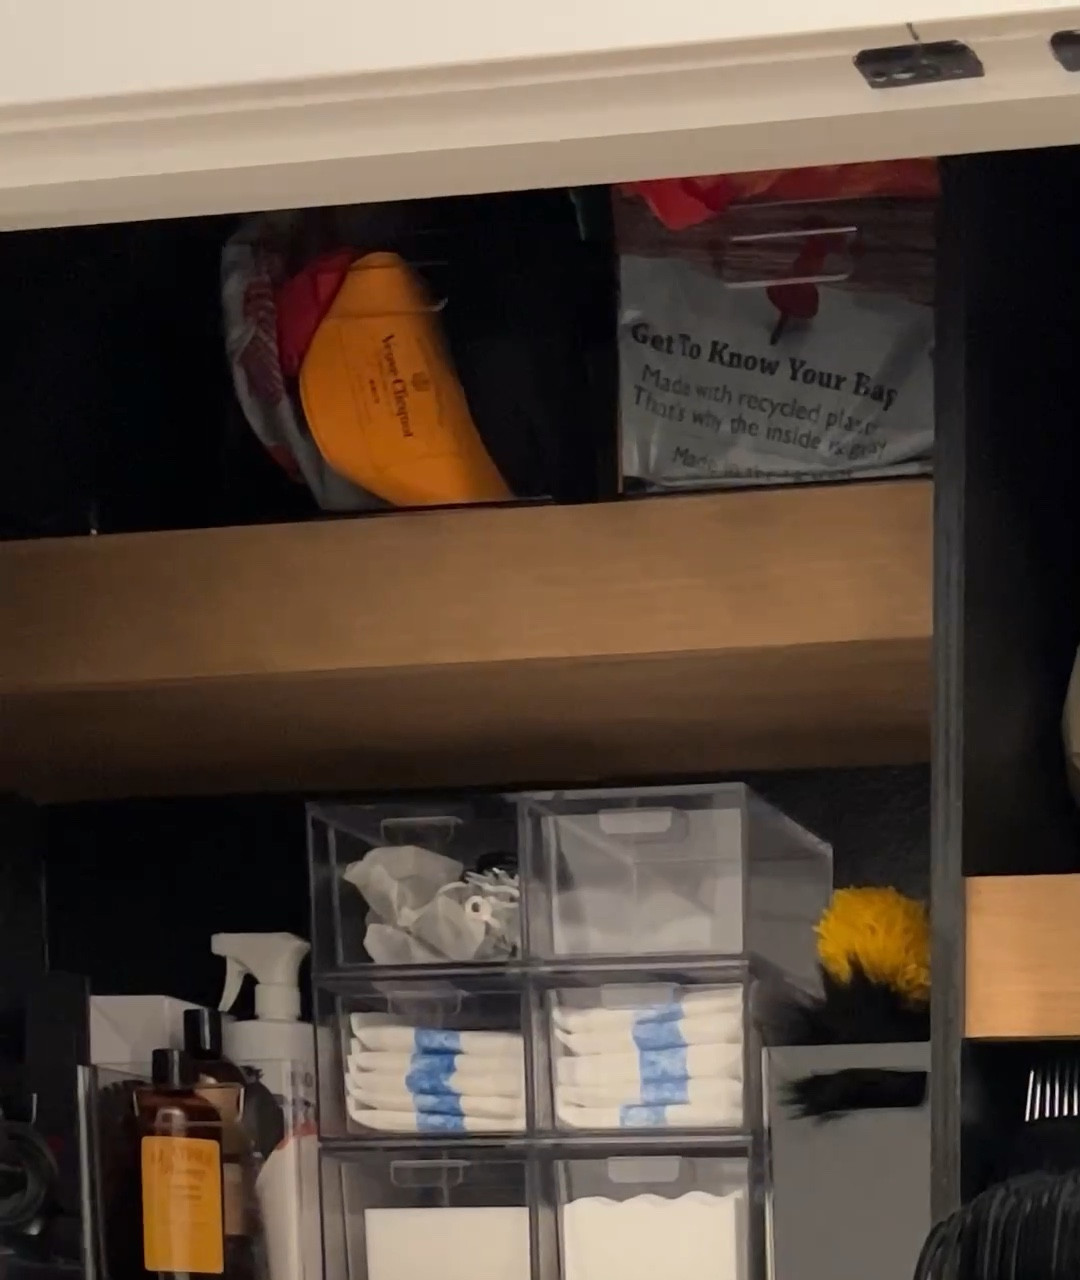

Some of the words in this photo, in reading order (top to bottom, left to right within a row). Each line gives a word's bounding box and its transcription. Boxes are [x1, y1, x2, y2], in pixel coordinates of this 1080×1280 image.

[632, 322, 674, 355] Get
[676, 333, 701, 360] To
[708, 340, 780, 376] Know
[788, 357, 847, 391] Your
[641, 364, 691, 398] Made
[695, 384, 732, 406] with
[738, 391, 820, 424] recycled
[826, 410, 878, 437] plac
[692, 409, 721, 434] why
[730, 414, 757, 438] the
[766, 420, 821, 452] inside
